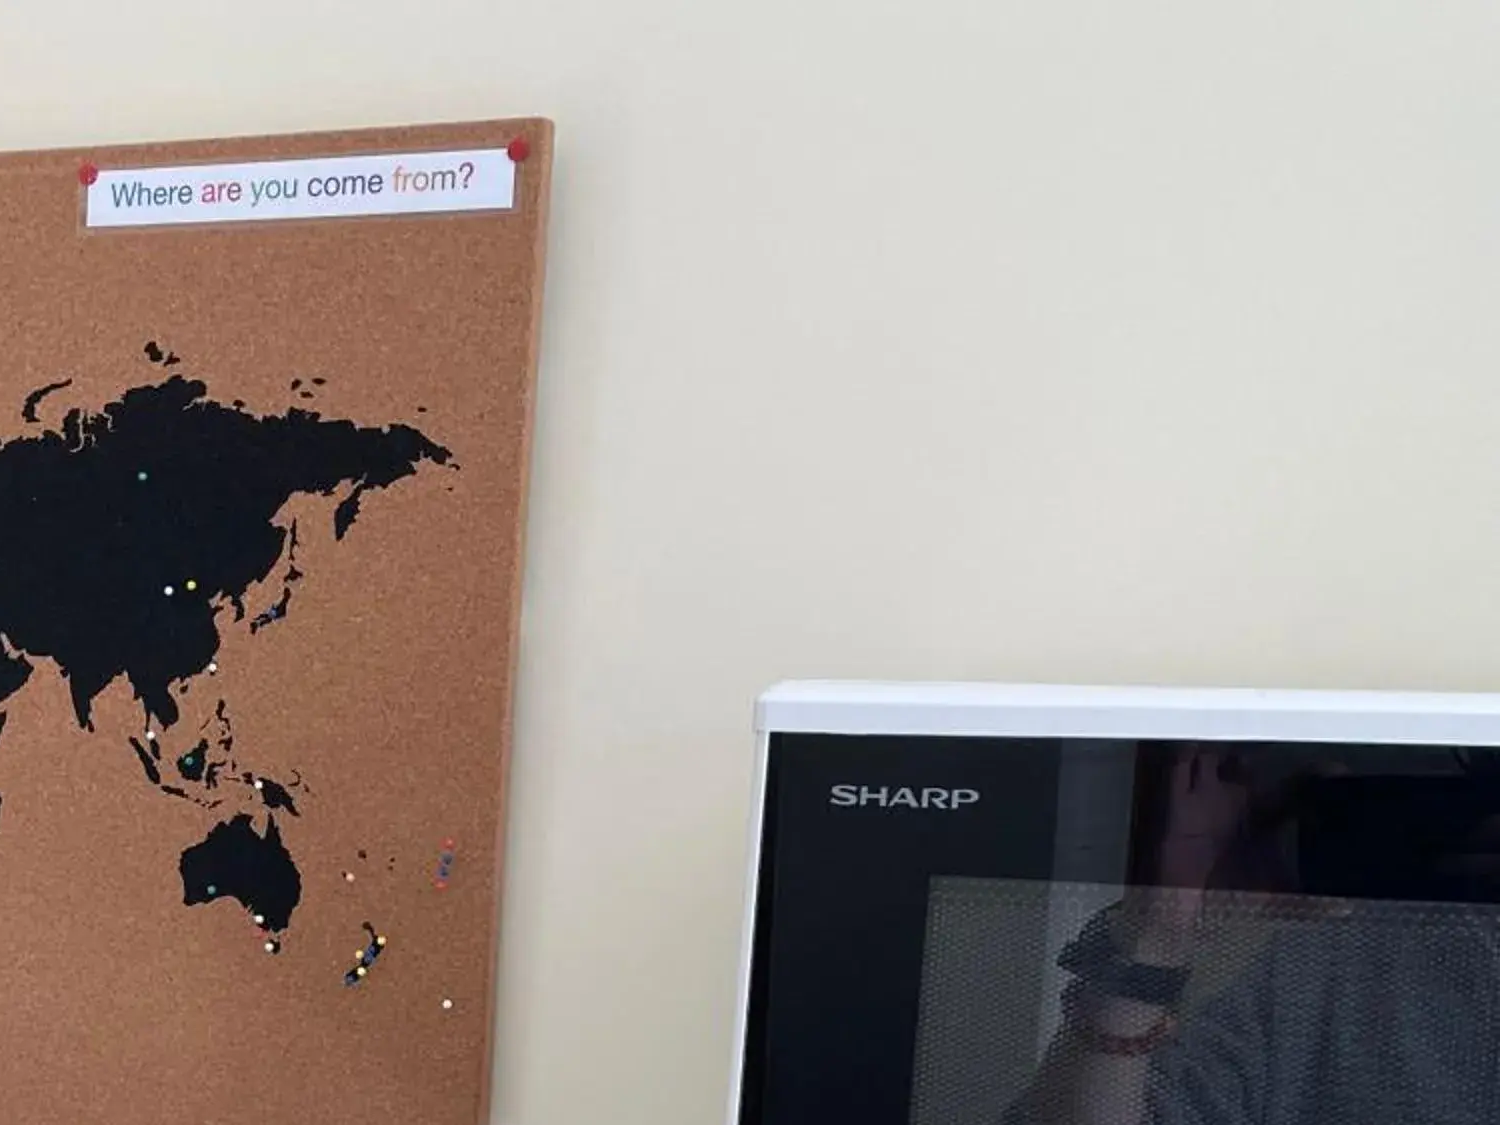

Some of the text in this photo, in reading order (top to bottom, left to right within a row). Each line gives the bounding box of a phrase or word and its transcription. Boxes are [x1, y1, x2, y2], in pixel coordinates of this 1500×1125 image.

[111, 161, 474, 209] Where are you come from?
[829, 783, 981, 810] SHARP
